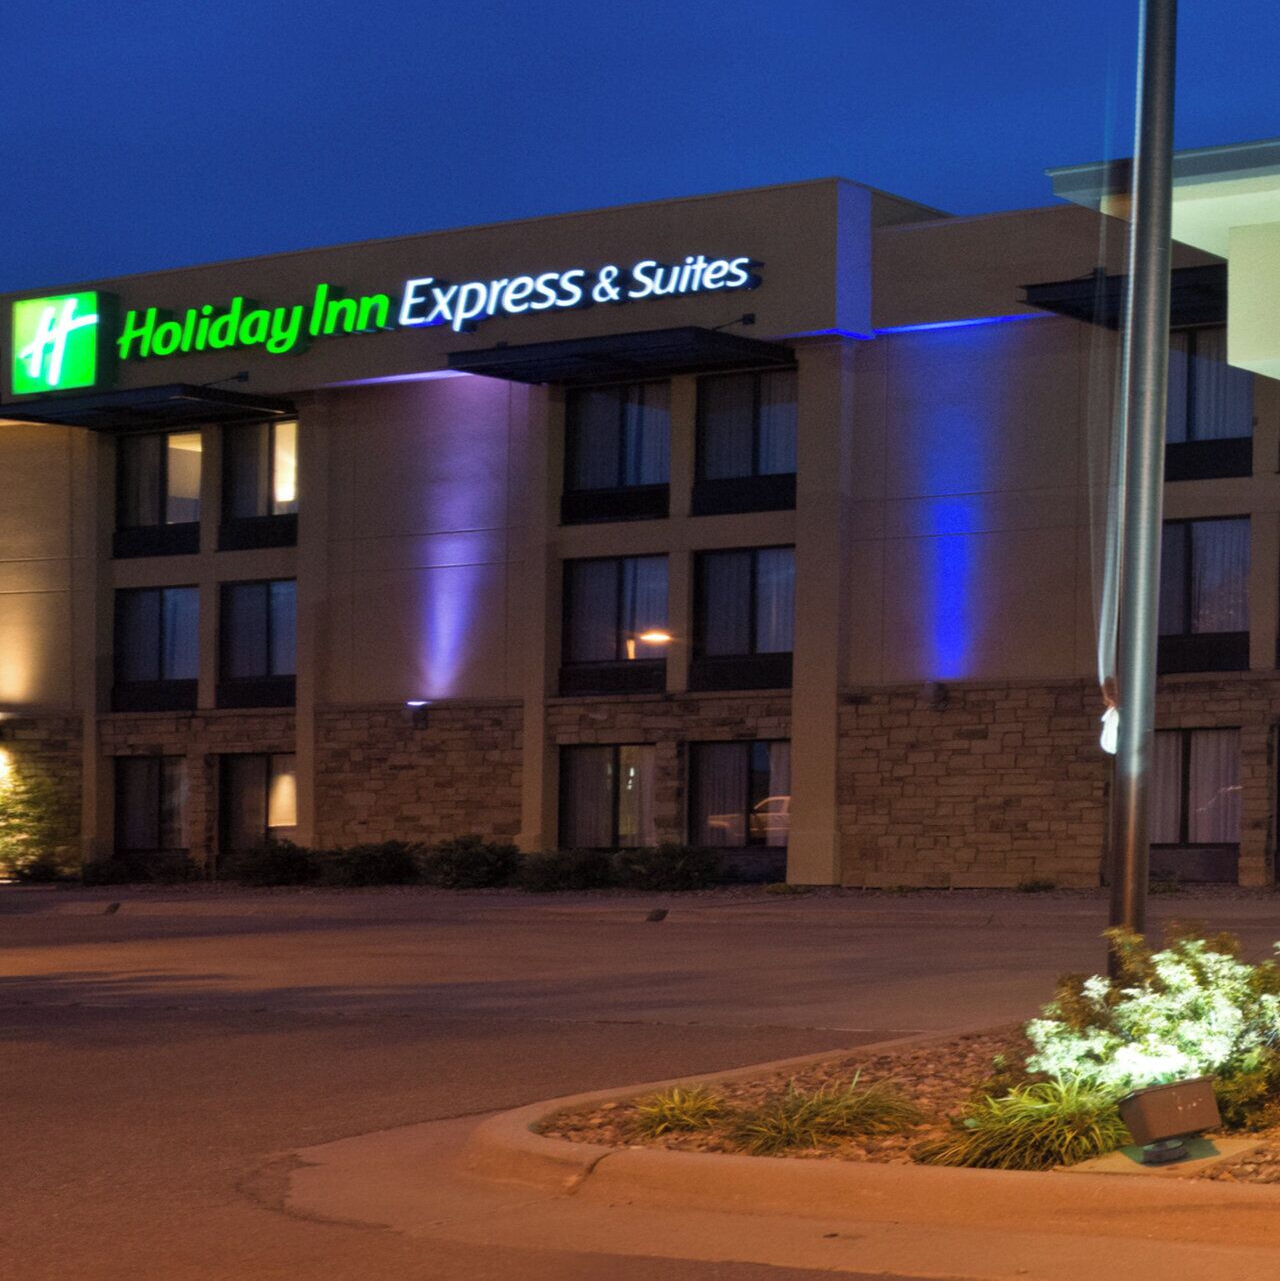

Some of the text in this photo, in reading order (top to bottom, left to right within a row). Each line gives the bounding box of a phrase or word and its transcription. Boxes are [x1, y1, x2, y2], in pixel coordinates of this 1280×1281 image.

[117, 255, 750, 360] Holiday Inn Express & Suites
